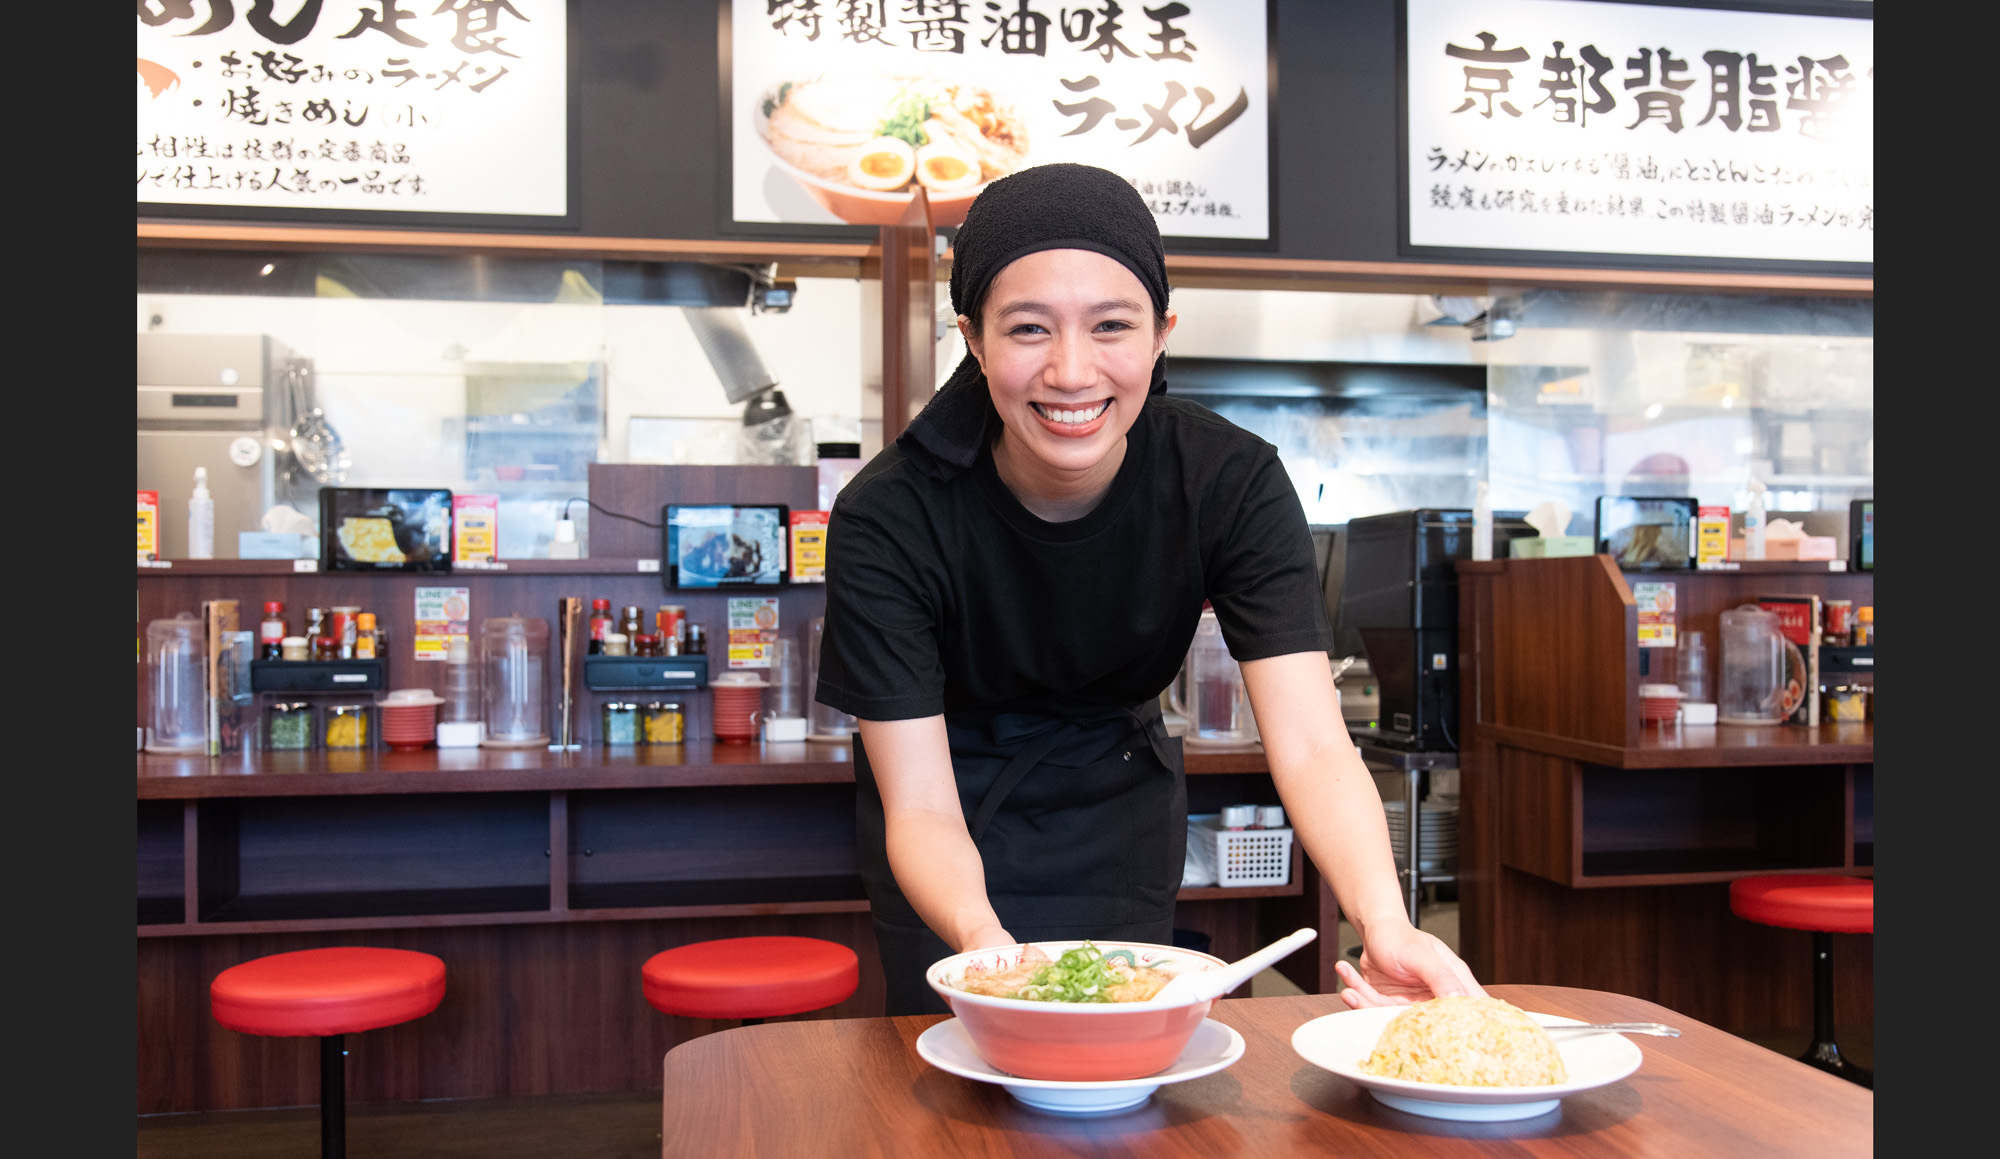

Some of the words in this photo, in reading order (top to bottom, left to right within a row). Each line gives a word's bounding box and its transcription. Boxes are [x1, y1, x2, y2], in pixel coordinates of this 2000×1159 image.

[1053, 75, 1249, 149] ラーメン
[1446, 31, 1873, 141] 京都背脂醤
